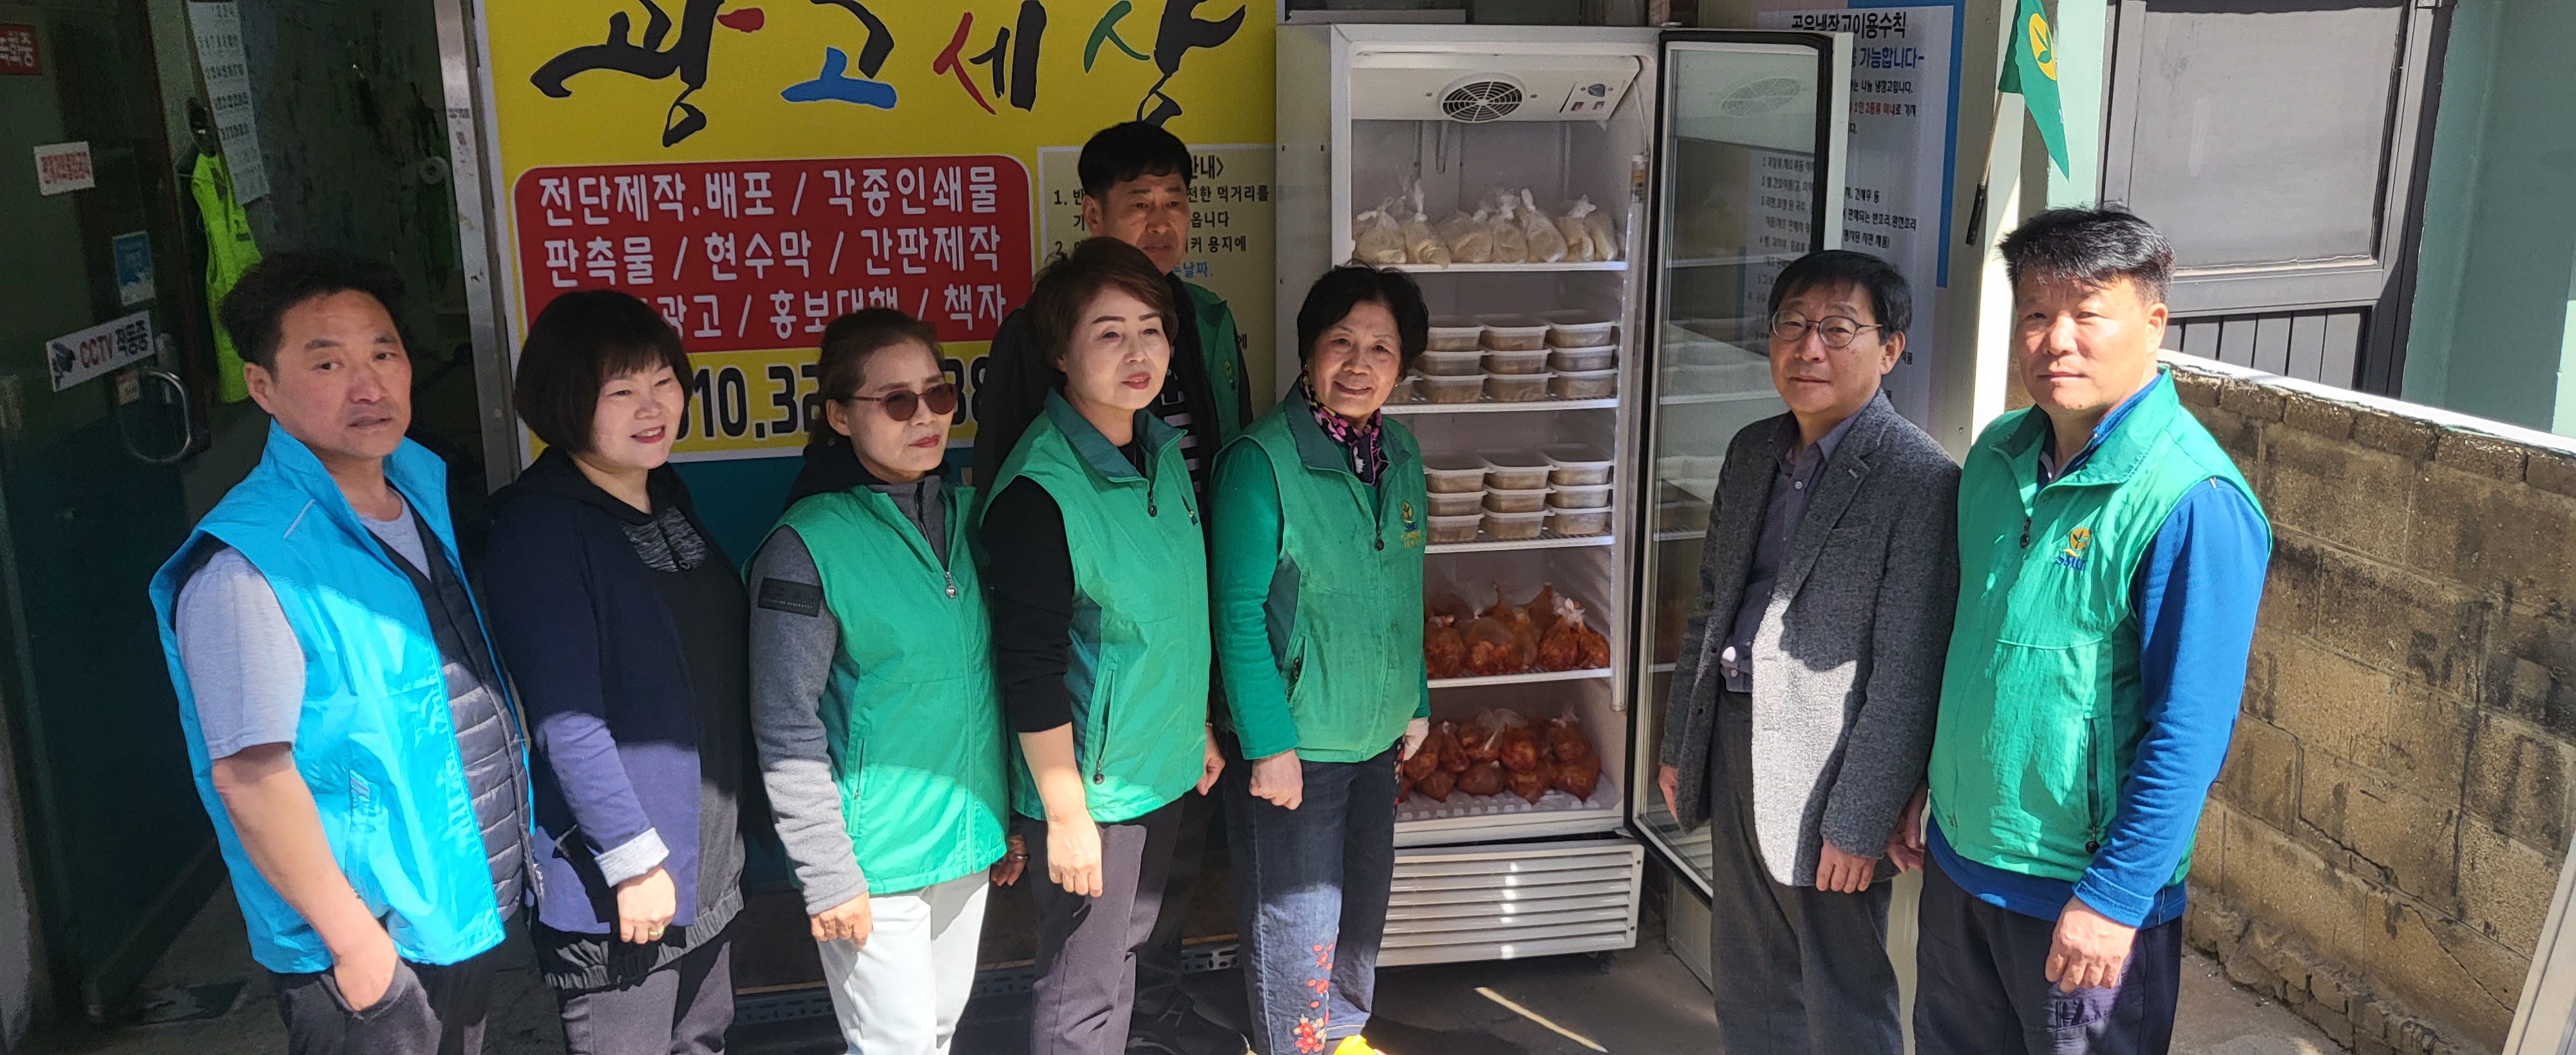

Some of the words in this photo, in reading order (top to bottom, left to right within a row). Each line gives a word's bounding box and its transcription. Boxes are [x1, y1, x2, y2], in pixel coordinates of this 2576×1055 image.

[1860, 46, 1925, 69] 가능합니다-
[1875, 80, 1913, 95] 냉장고입니다.
[538, 171, 775, 227] 전단제작.배포
[823, 166, 997, 218] 각종인쇄물
[1217, 184, 1269, 203] 먹거리를
[1873, 191, 1880, 204] 등
[544, 235, 654, 288] 판촉물
[704, 229, 811, 281] 현수막
[860, 223, 1001, 276] 간판제작
[1208, 235, 1246, 253] 용지에
[944, 283, 1007, 331] 책자
[79, 332, 113, 369] CCTV
[115, 319, 148, 357] 작동중
